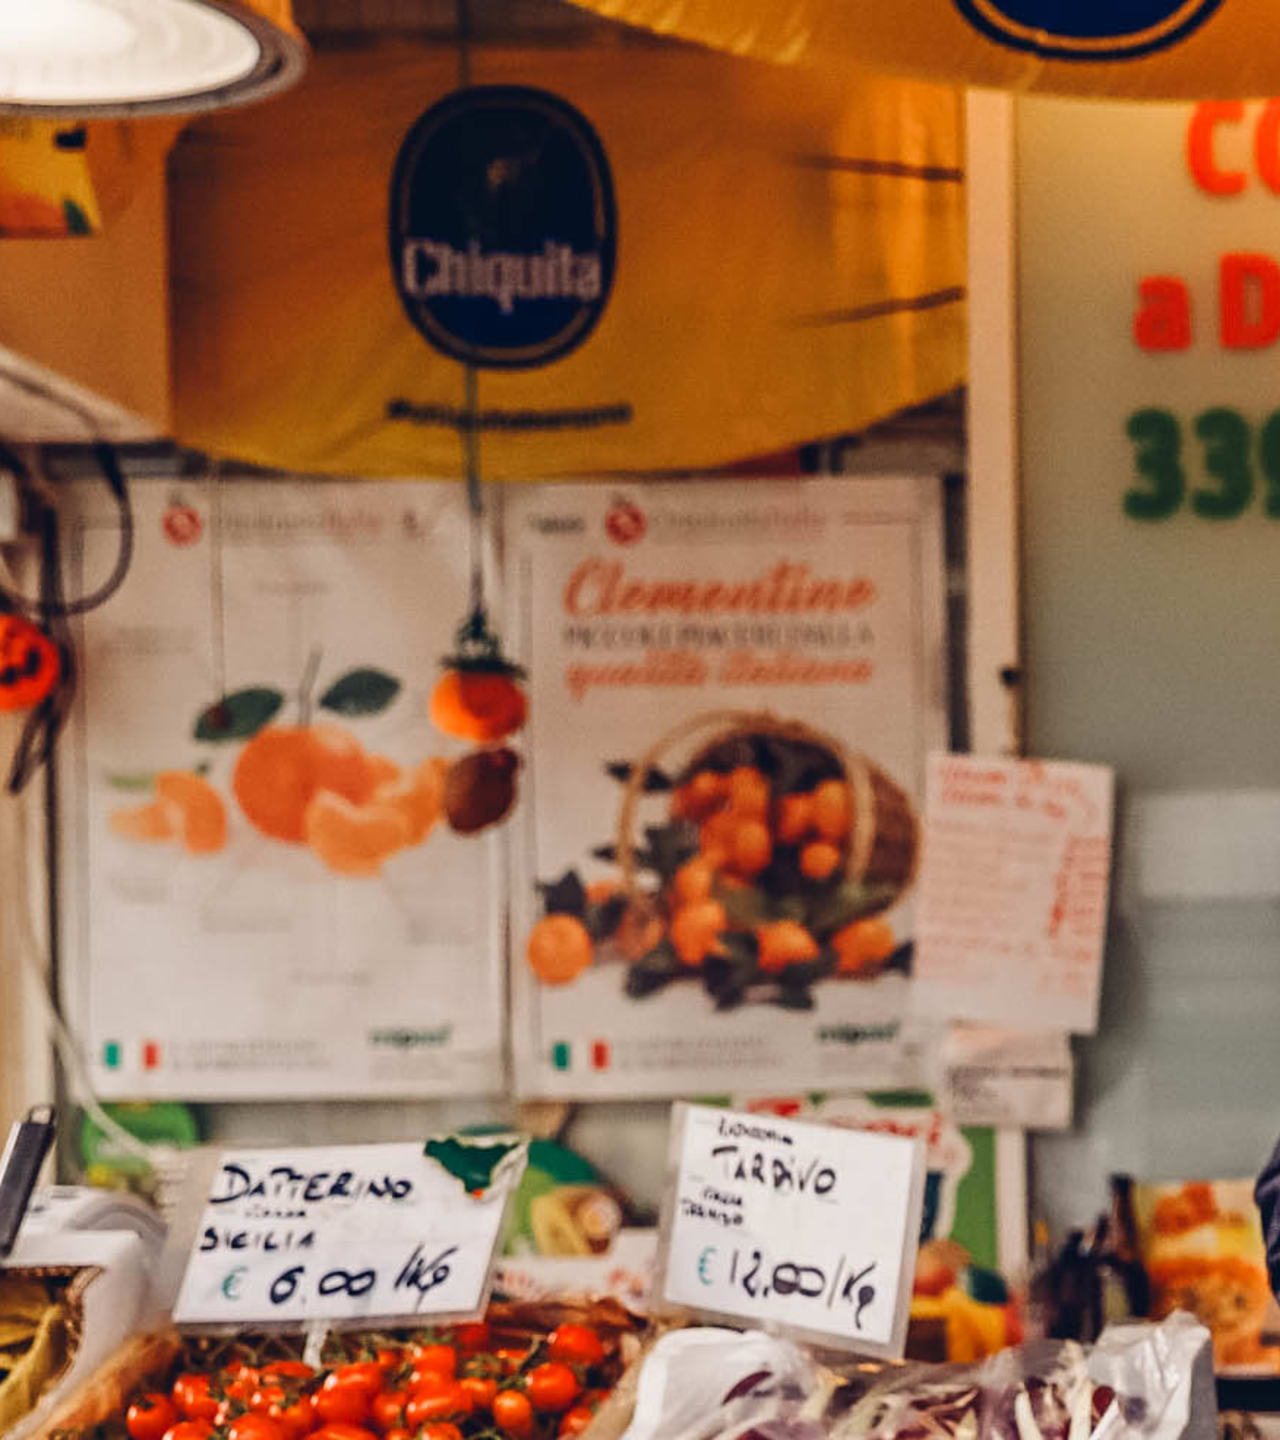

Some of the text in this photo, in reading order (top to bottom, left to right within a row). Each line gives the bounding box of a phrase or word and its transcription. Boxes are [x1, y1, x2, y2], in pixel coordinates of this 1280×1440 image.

[401, 236, 602, 314] Chiquita
[1132, 274, 1193, 354] a
[562, 555, 875, 619] Clementine
[209, 1164, 413, 1205] DATTERINO
[711, 1144, 838, 1196] TARDIVO
[200, 1226, 315, 1250] SICILIA
